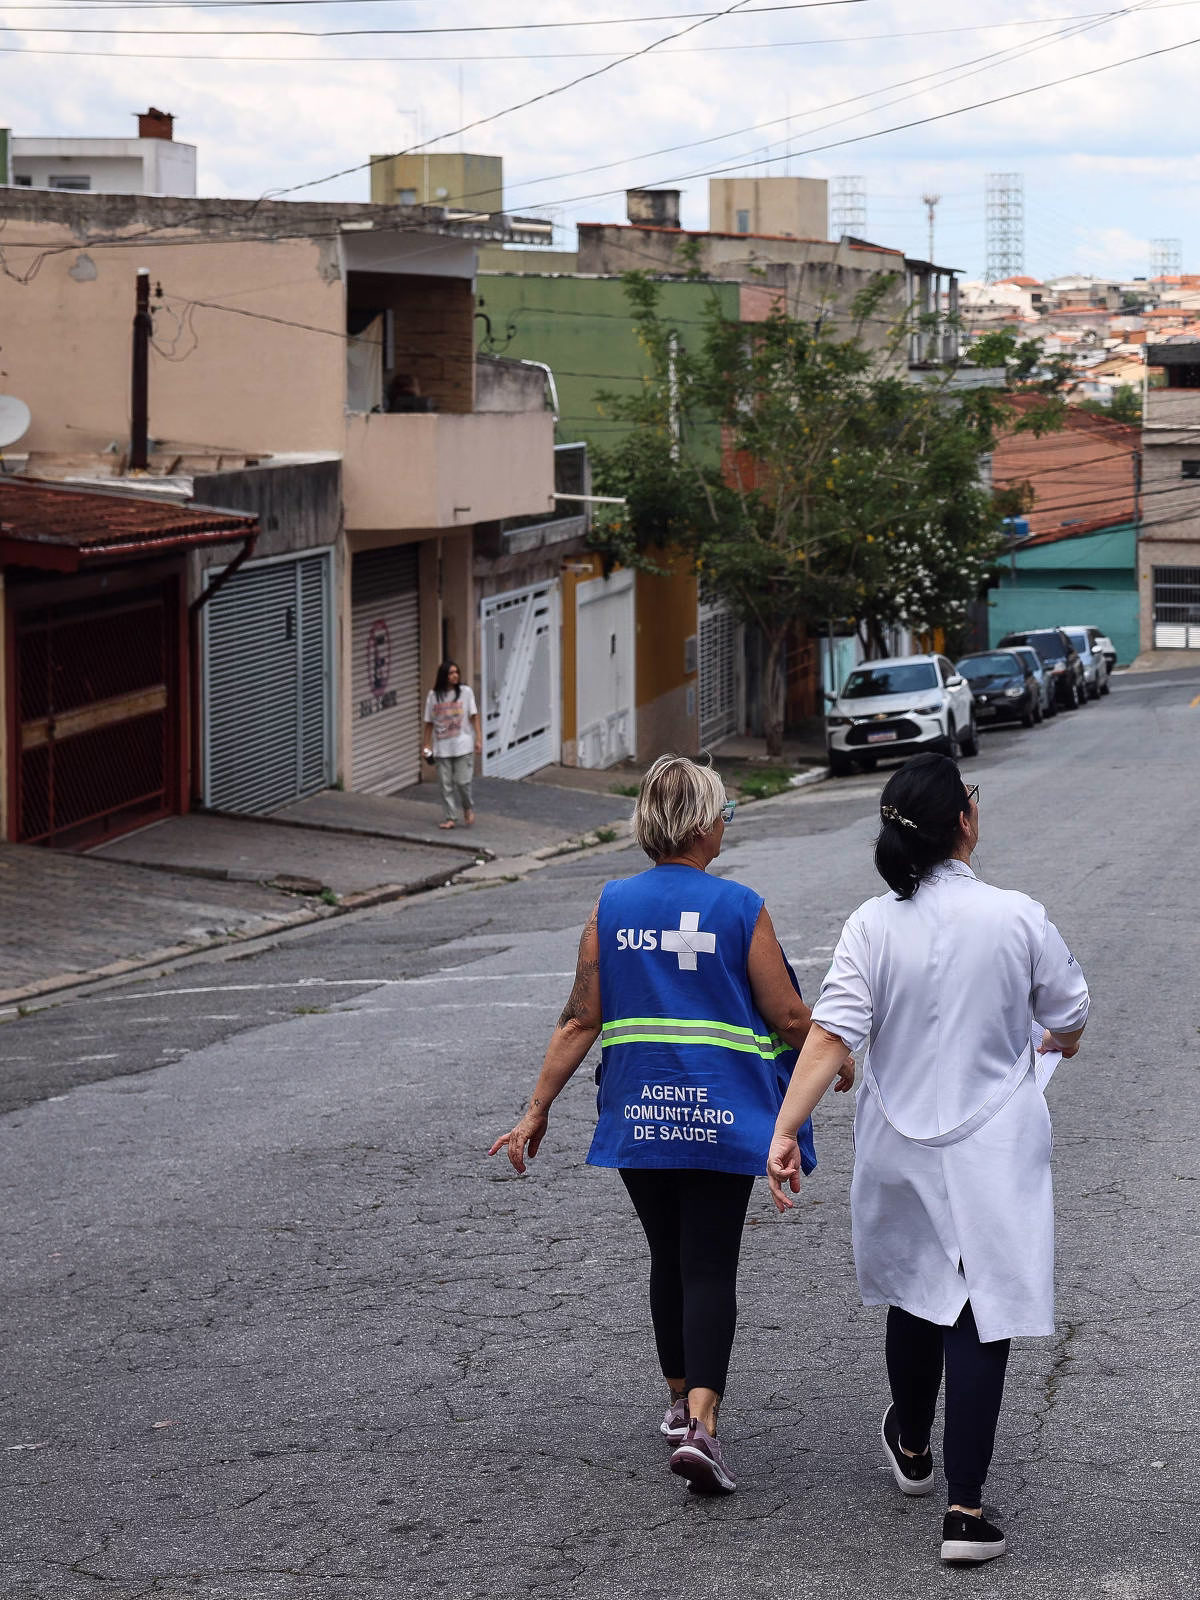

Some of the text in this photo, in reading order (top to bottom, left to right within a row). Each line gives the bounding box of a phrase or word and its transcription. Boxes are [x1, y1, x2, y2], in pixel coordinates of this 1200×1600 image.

[616, 928, 658, 951] SUS
[640, 1084, 708, 1103] AGENTE
[624, 1104, 735, 1125] COMUNITÁRIO
[634, 1123, 718, 1144] DE SAÚDE
